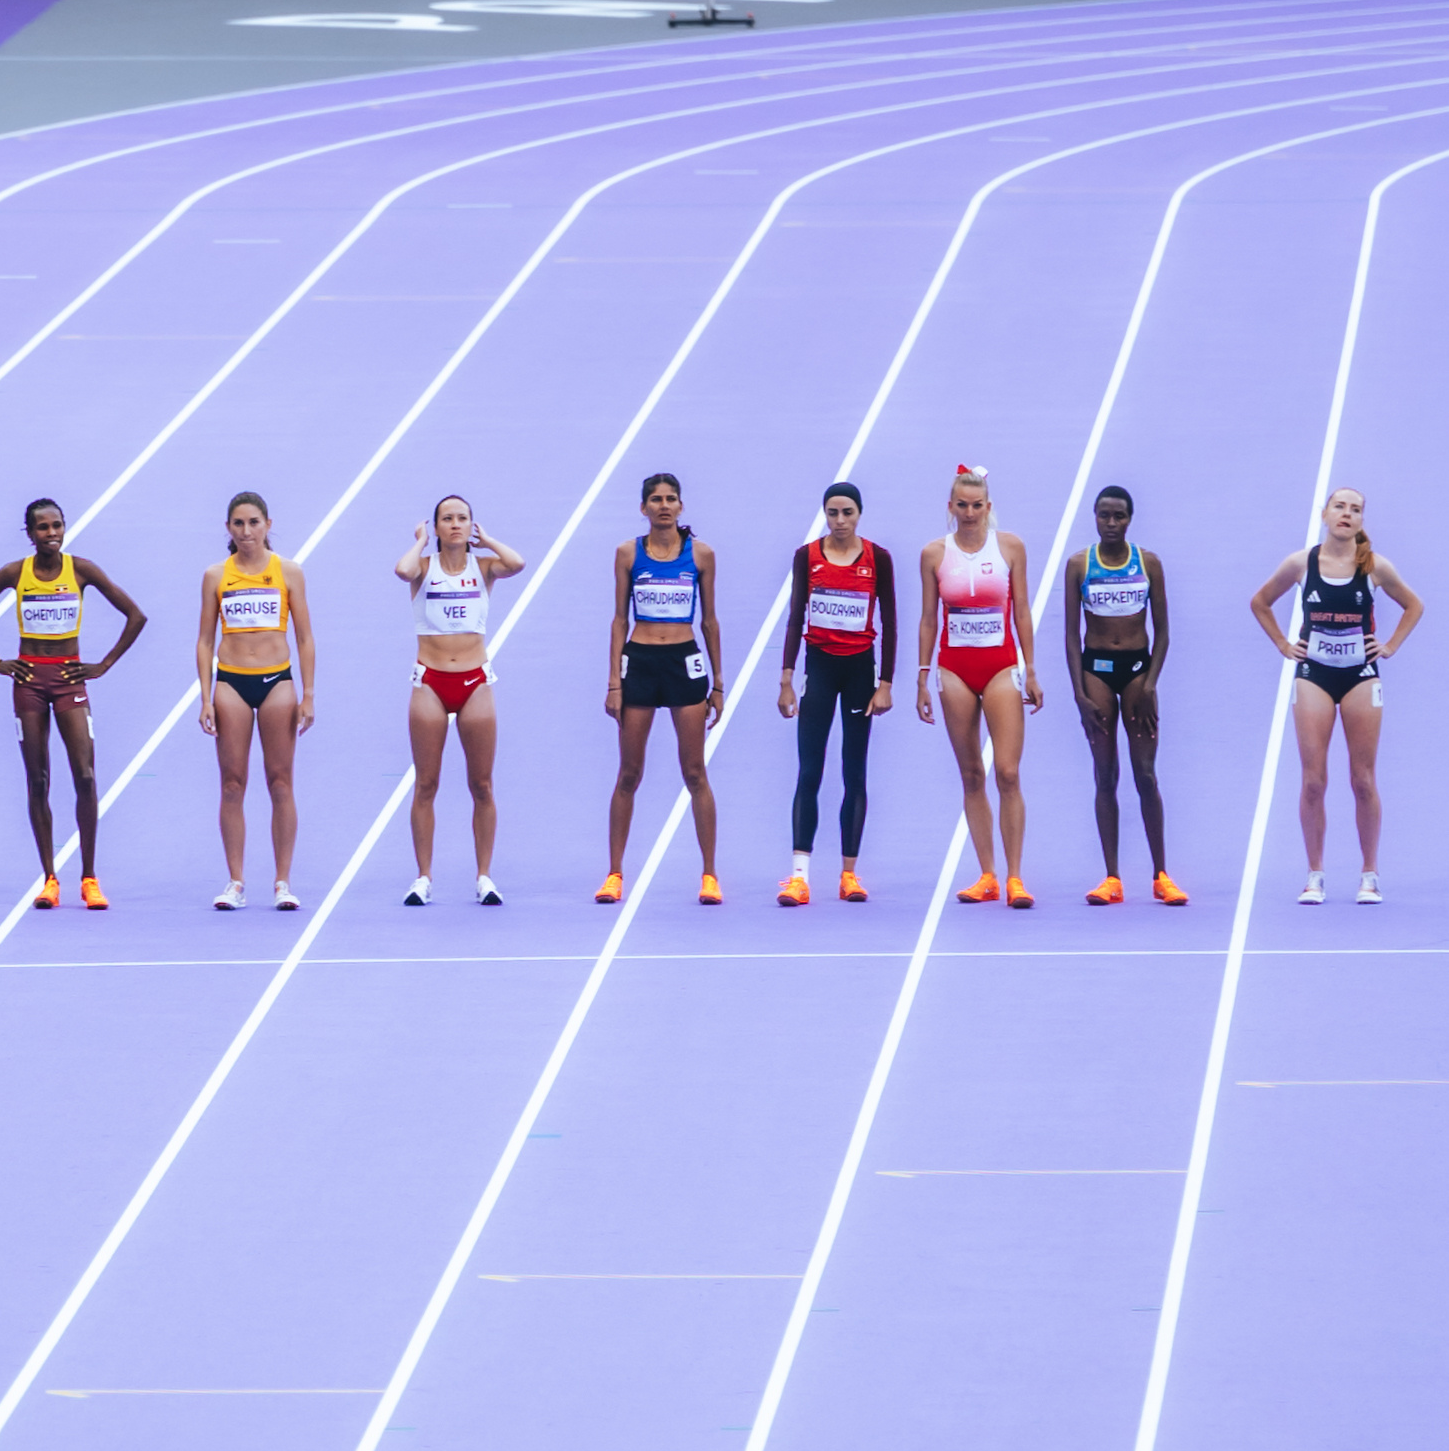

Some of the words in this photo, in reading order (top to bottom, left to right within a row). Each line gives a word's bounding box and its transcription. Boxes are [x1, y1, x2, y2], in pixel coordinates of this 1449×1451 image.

[636, 591, 692, 605] CHAUDHARY
[23, 606, 78, 621] CHEMUTAI
[224, 601, 278, 616] KRAUSE
[443, 605, 467, 619] YEE
[811, 601, 865, 620] BOUZAYANI
[960, 620, 1003, 635] KONIECZEK
[1317, 640, 1357, 656] PRATT
[693, 658, 703, 673] 5
